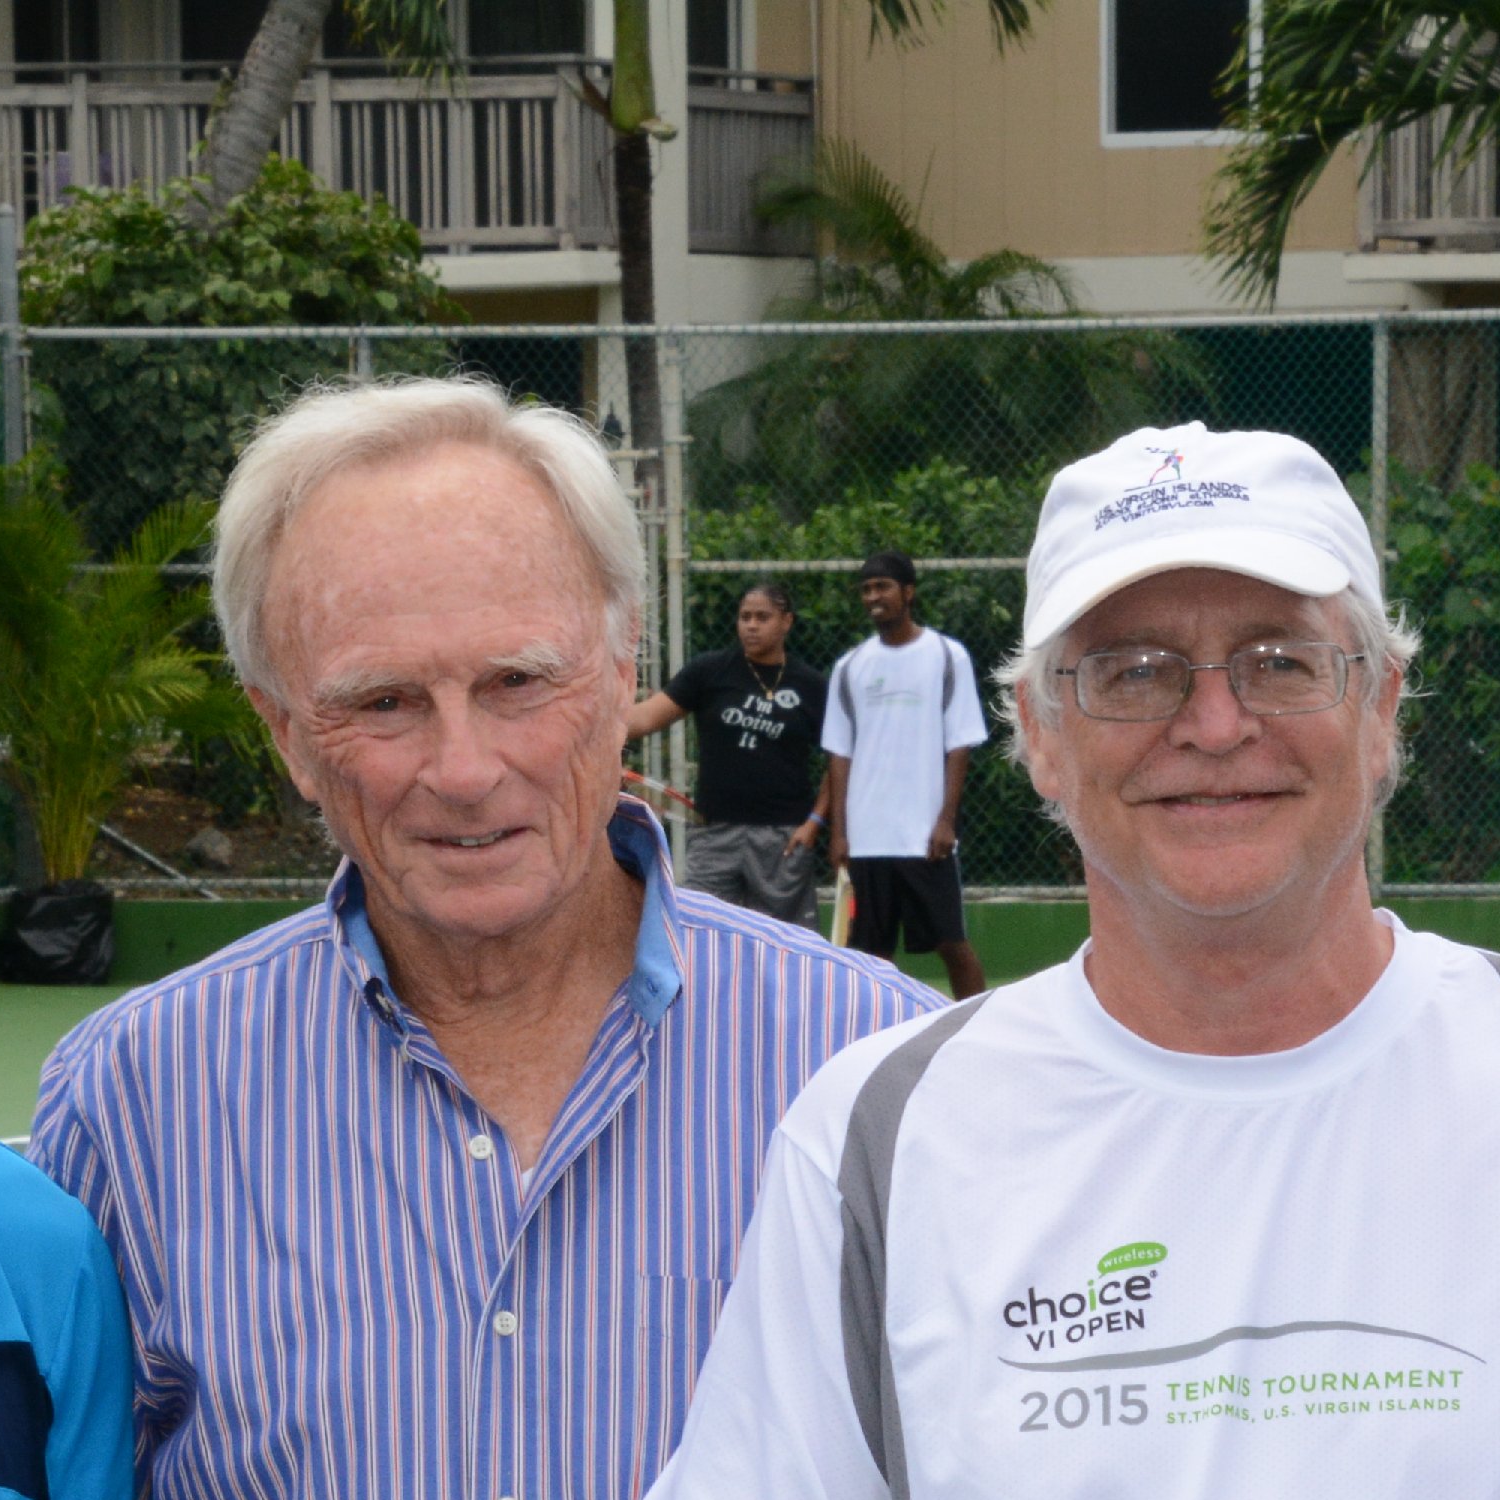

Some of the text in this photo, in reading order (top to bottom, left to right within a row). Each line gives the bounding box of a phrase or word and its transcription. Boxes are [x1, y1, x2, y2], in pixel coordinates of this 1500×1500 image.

[1116, 486, 1166, 508] VIRGIN
[721, 707, 785, 739] Doing
[1103, 1247, 1161, 1269] wireless
[1026, 1308, 1145, 1351] VI OPEN
[1019, 1370, 1463, 1433] 2015 TENNIS TOURNAMENT
[1264, 1405, 1295, 1421] U.S.
[1305, 1401, 1371, 1415] VIRGIN
[1379, 1399, 1462, 1412] ISLANDS
